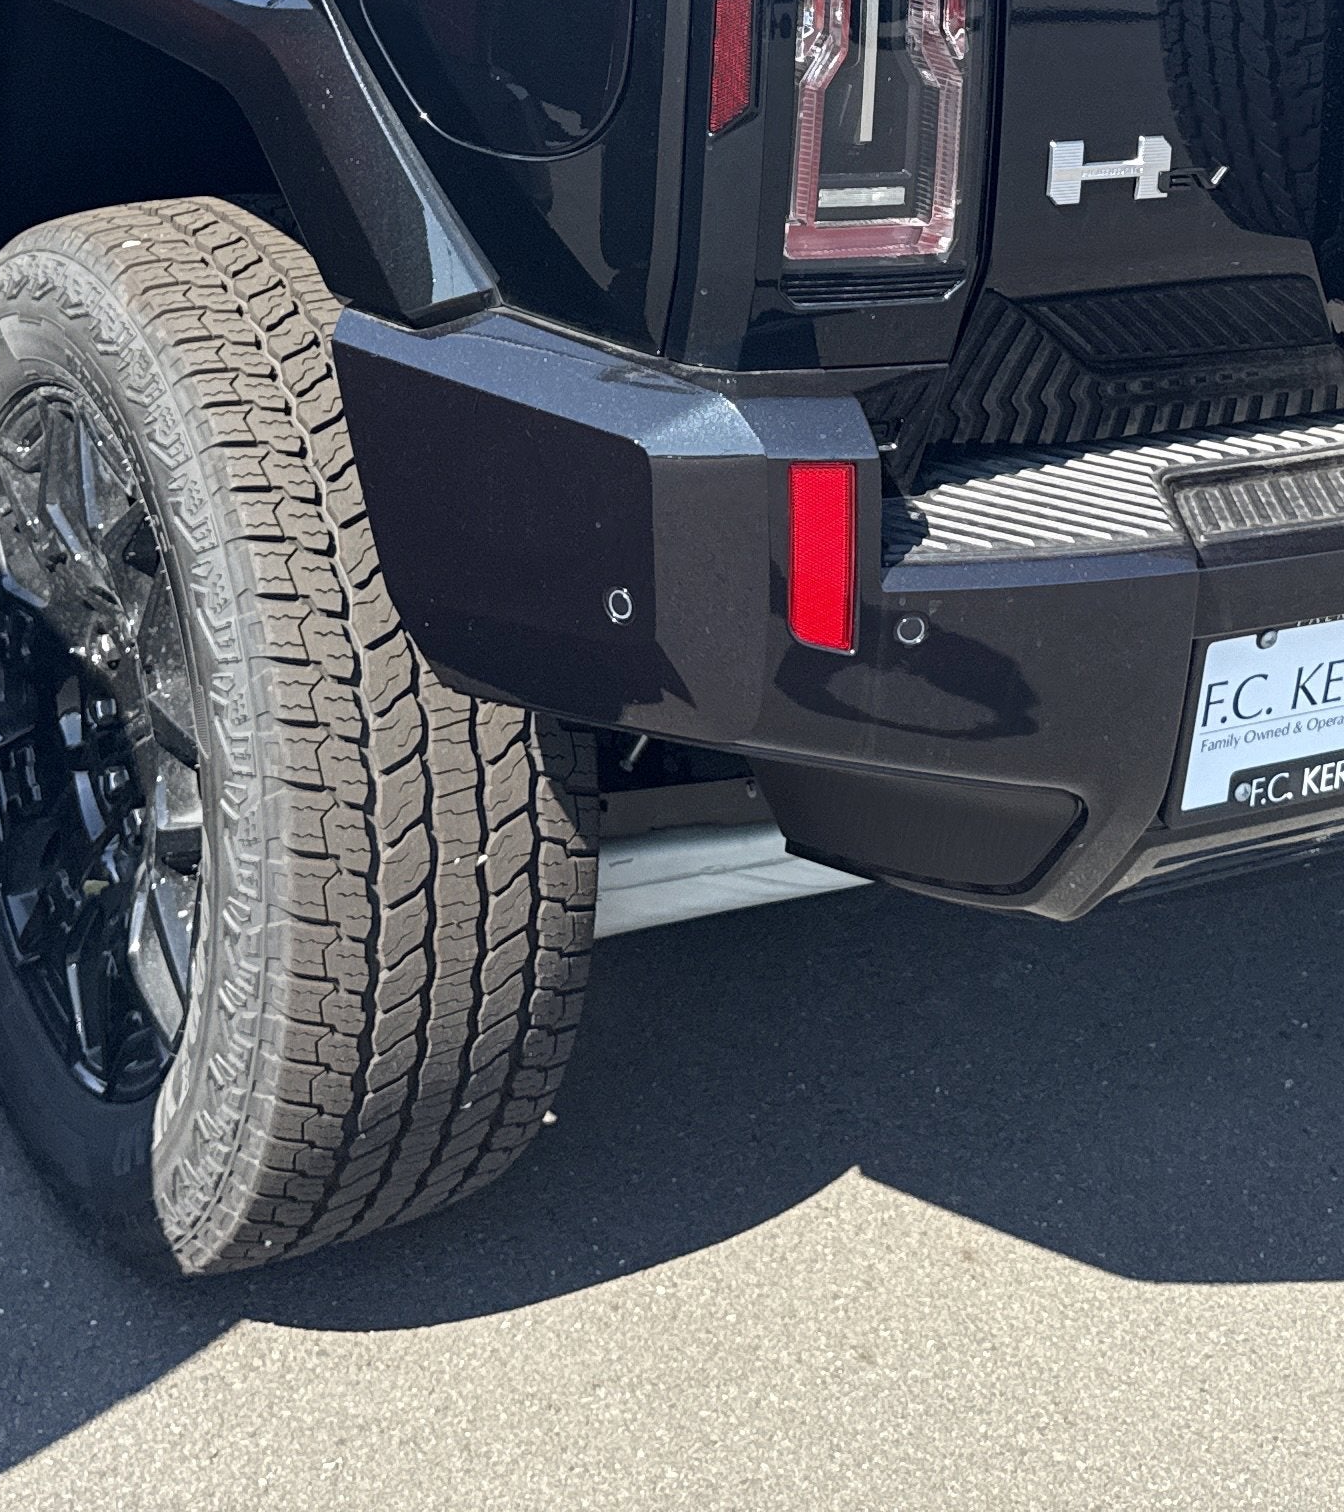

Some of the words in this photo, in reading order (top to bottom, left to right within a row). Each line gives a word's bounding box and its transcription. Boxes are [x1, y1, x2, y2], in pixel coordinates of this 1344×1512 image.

[1200, 672, 1273, 728] F.C.
[1200, 732, 1242, 753] Family
[1243, 723, 1290, 745] Owned
[1292, 722, 1304, 735] &
[1249, 772, 1294, 807] F.C.
